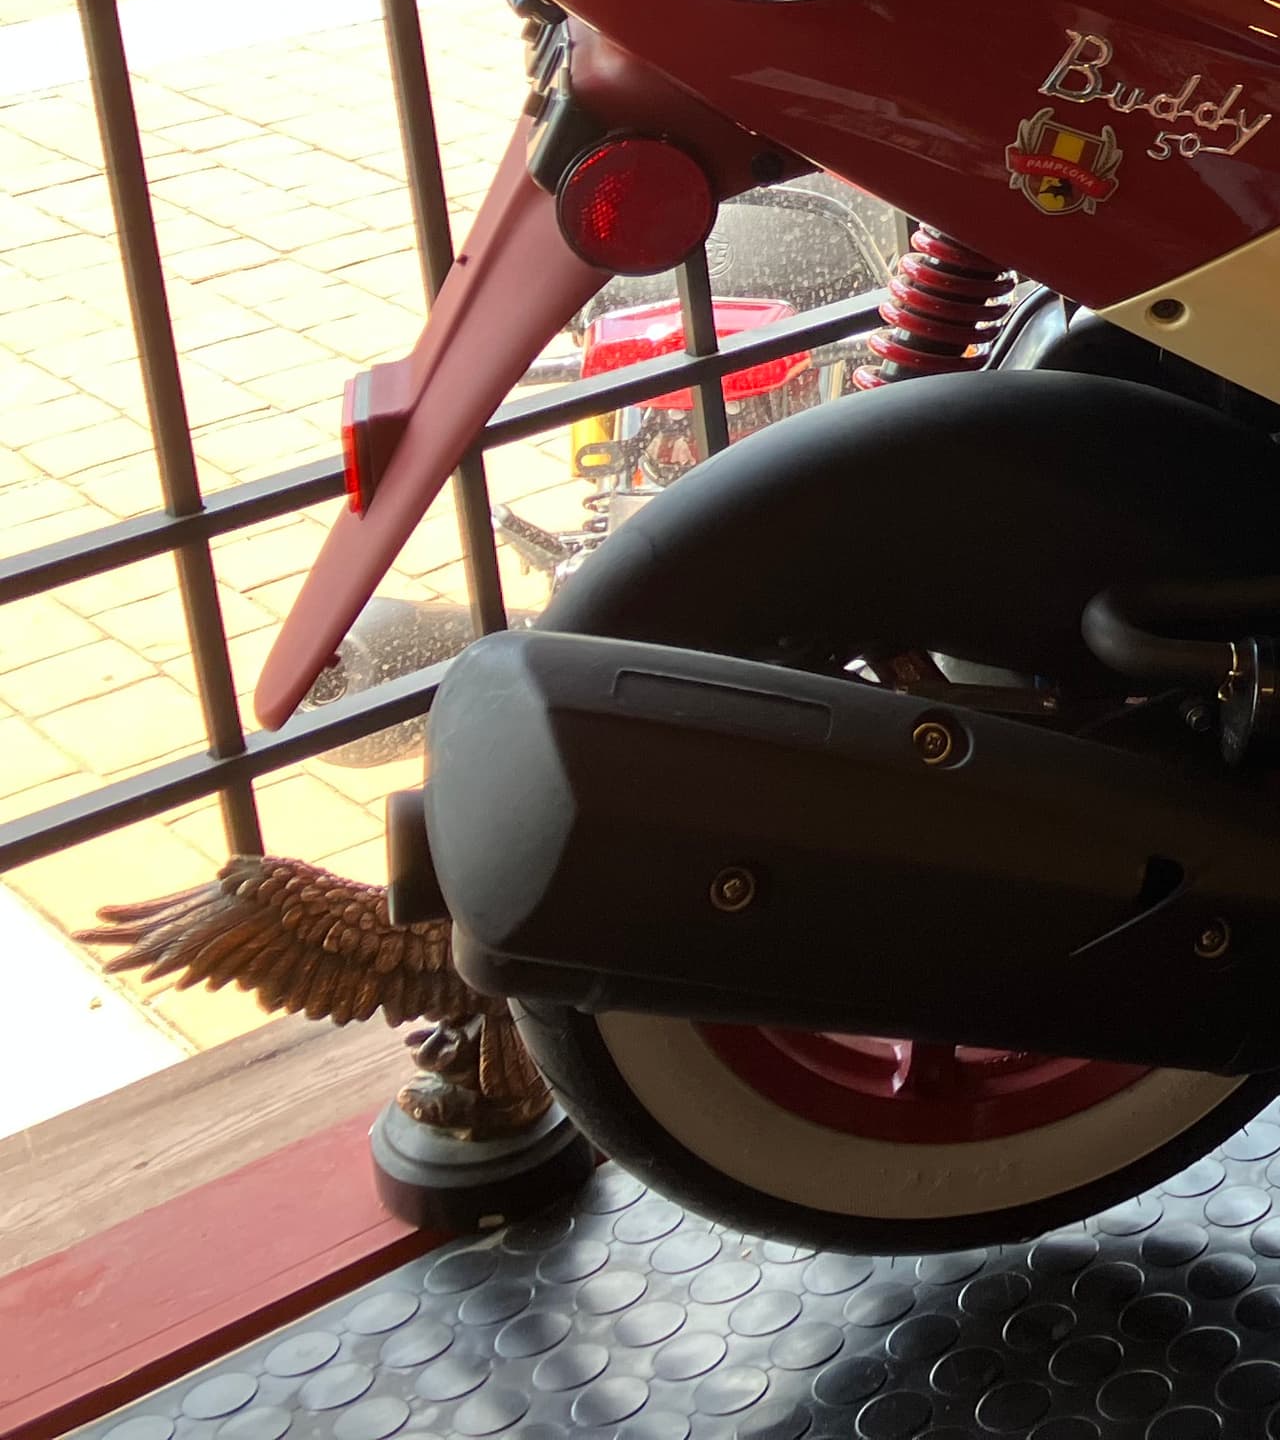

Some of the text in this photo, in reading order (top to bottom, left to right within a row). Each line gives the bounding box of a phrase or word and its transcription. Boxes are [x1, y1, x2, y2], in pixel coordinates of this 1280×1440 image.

[1037, 28, 1272, 156] Buddy
[1146, 131, 1200, 160] 50
[1026, 159, 1095, 189] PAMPLONA
